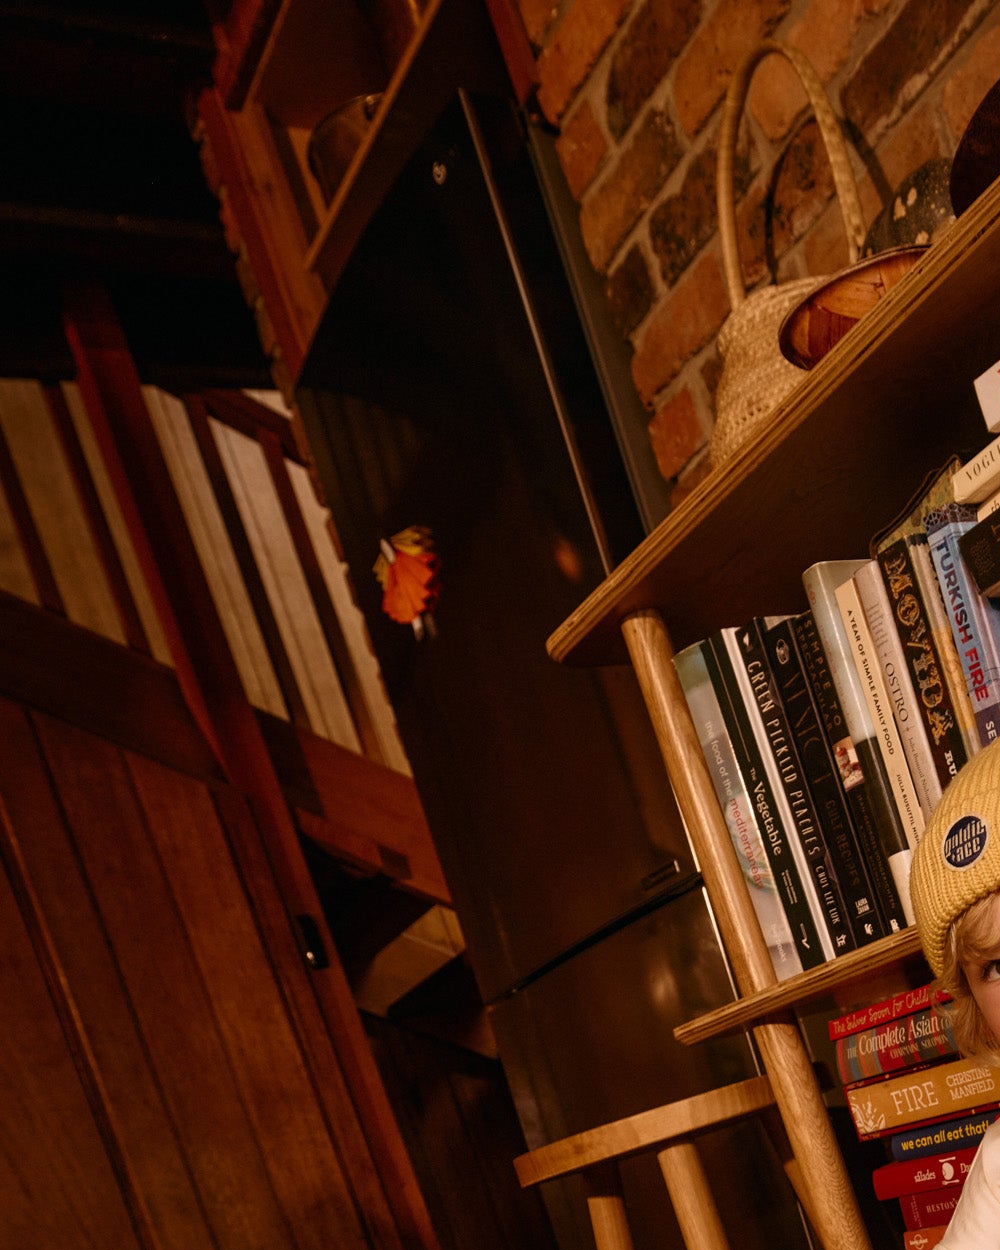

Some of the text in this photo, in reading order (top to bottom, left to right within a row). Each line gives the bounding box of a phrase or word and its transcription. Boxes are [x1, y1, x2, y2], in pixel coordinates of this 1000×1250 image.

[879, 551, 956, 745] MOVIDA
[932, 538, 991, 704] TURKISH FIRE
[846, 608, 896, 756] A YEAR OF SIMPLE FAMILY FOOD
[884, 662, 908, 722] OSTRO
[747, 660, 774, 712] GREEN
[765, 717, 797, 783] PICKLED
[789, 789, 820, 855] PEACHES
[702, 720, 767, 891] the food of the mediterranean
[748, 765, 782, 855] The Vegetable
[858, 1013, 939, 1055] Complete Asian
[889, 1080, 939, 1115] FIRE
[944, 1063, 993, 1088] CHRISTINE
[948, 1076, 997, 1102] MANFIELD
[899, 1118, 991, 1152] we can all eat that!
